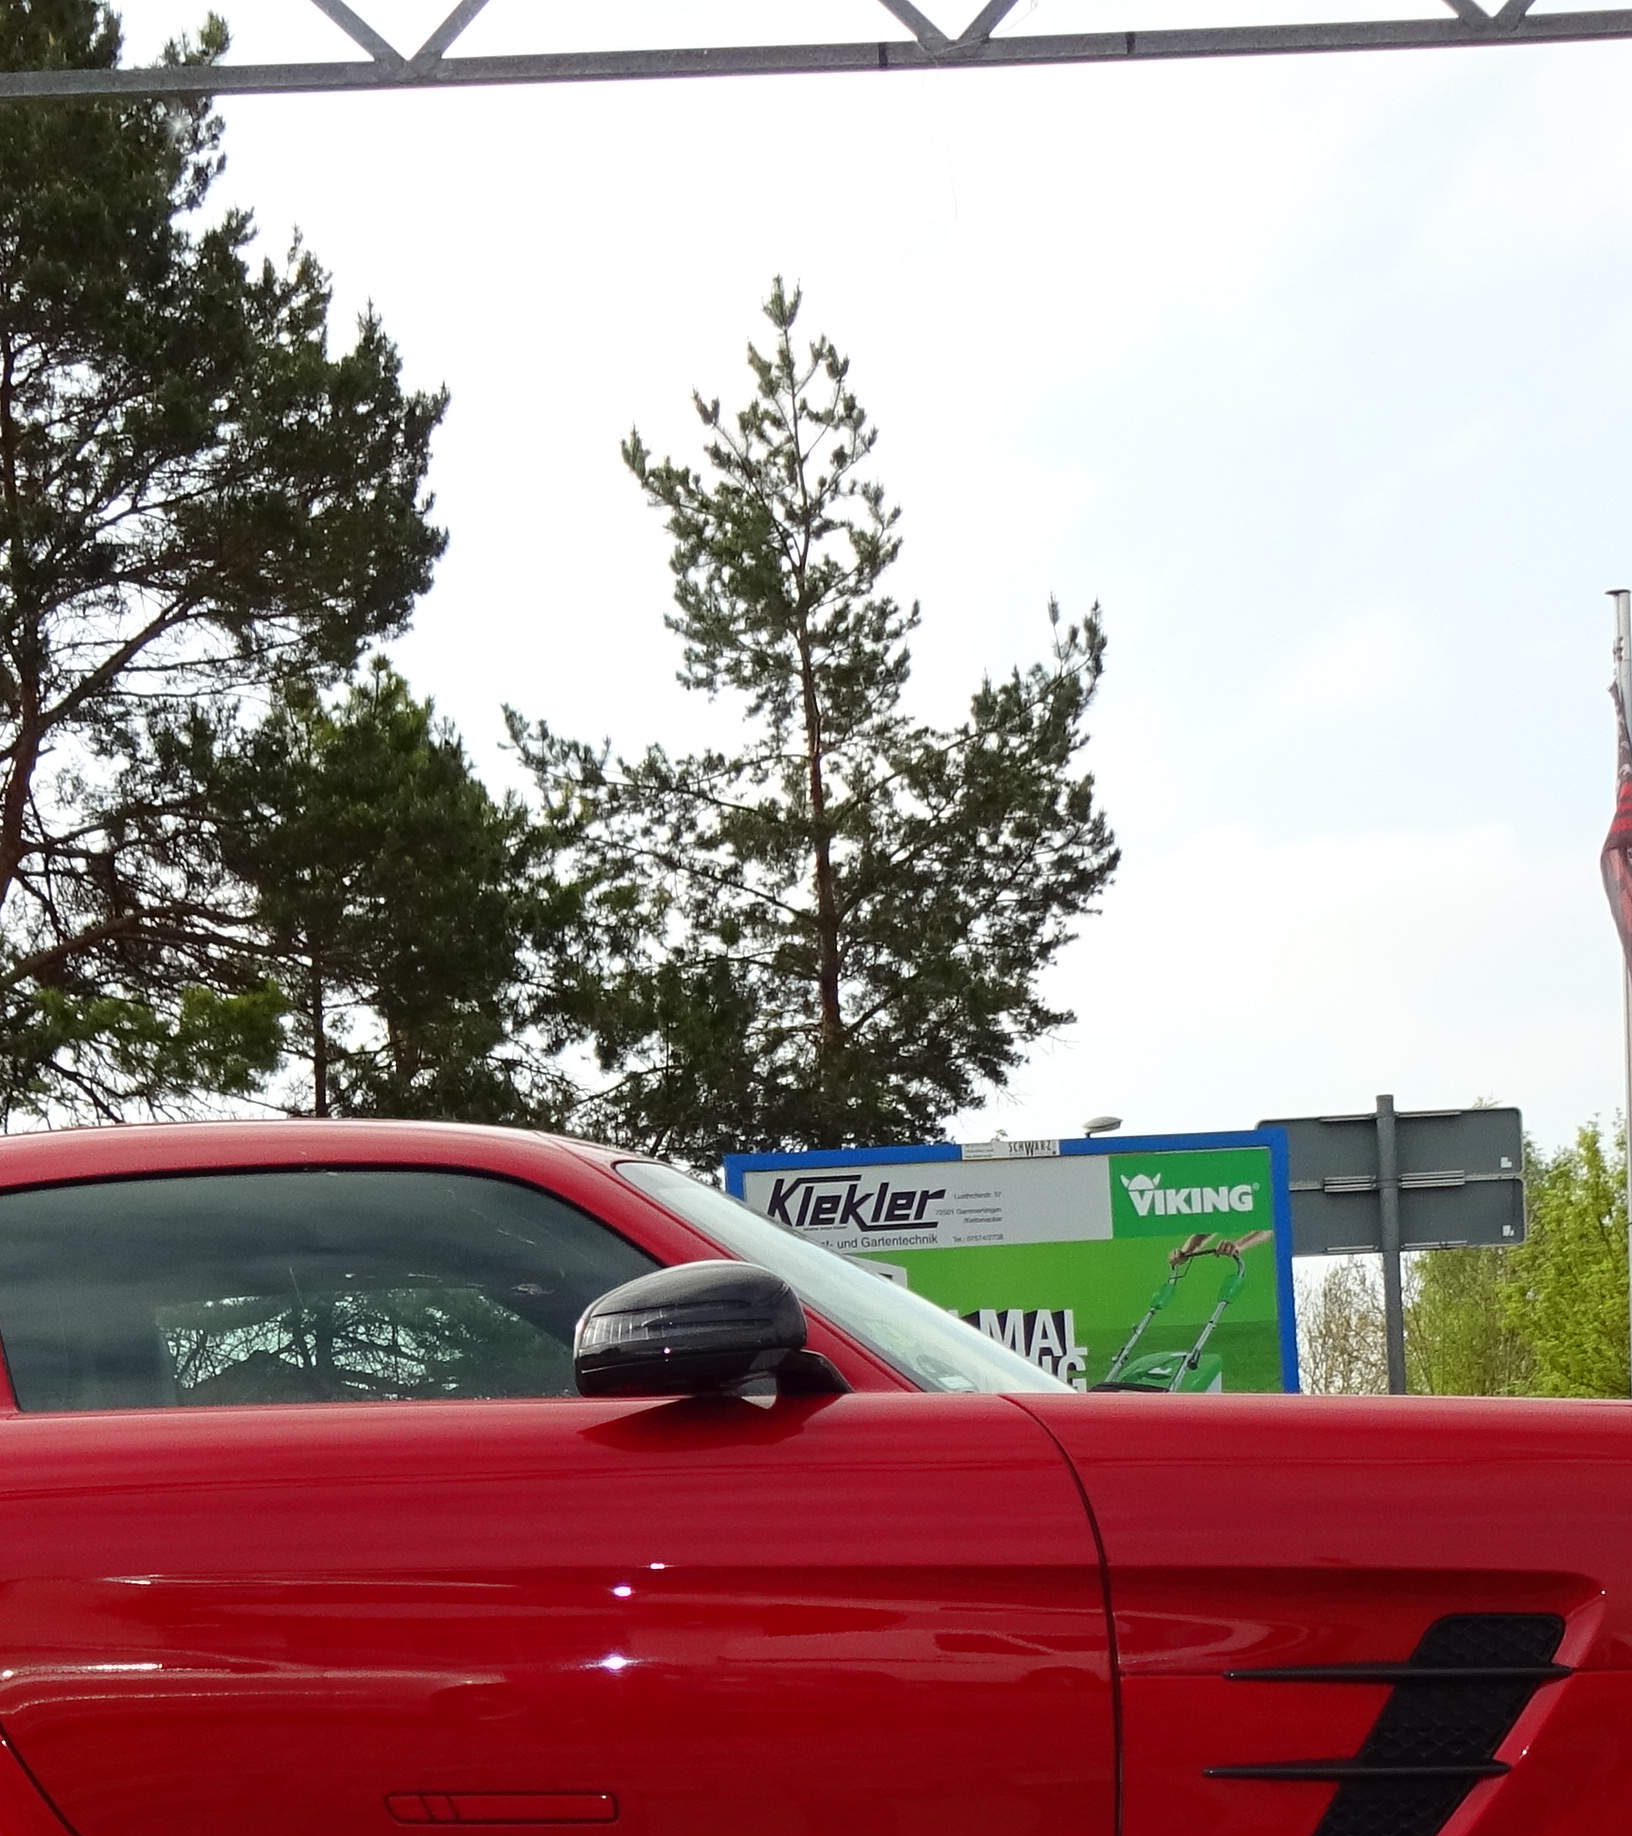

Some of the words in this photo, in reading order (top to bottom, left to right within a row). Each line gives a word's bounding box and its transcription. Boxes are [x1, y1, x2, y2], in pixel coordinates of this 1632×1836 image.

[1128, 1184, 1254, 1217] VIKING
[837, 1236, 858, 1249] und
[861, 1233, 939, 1249] Gartentechnik
